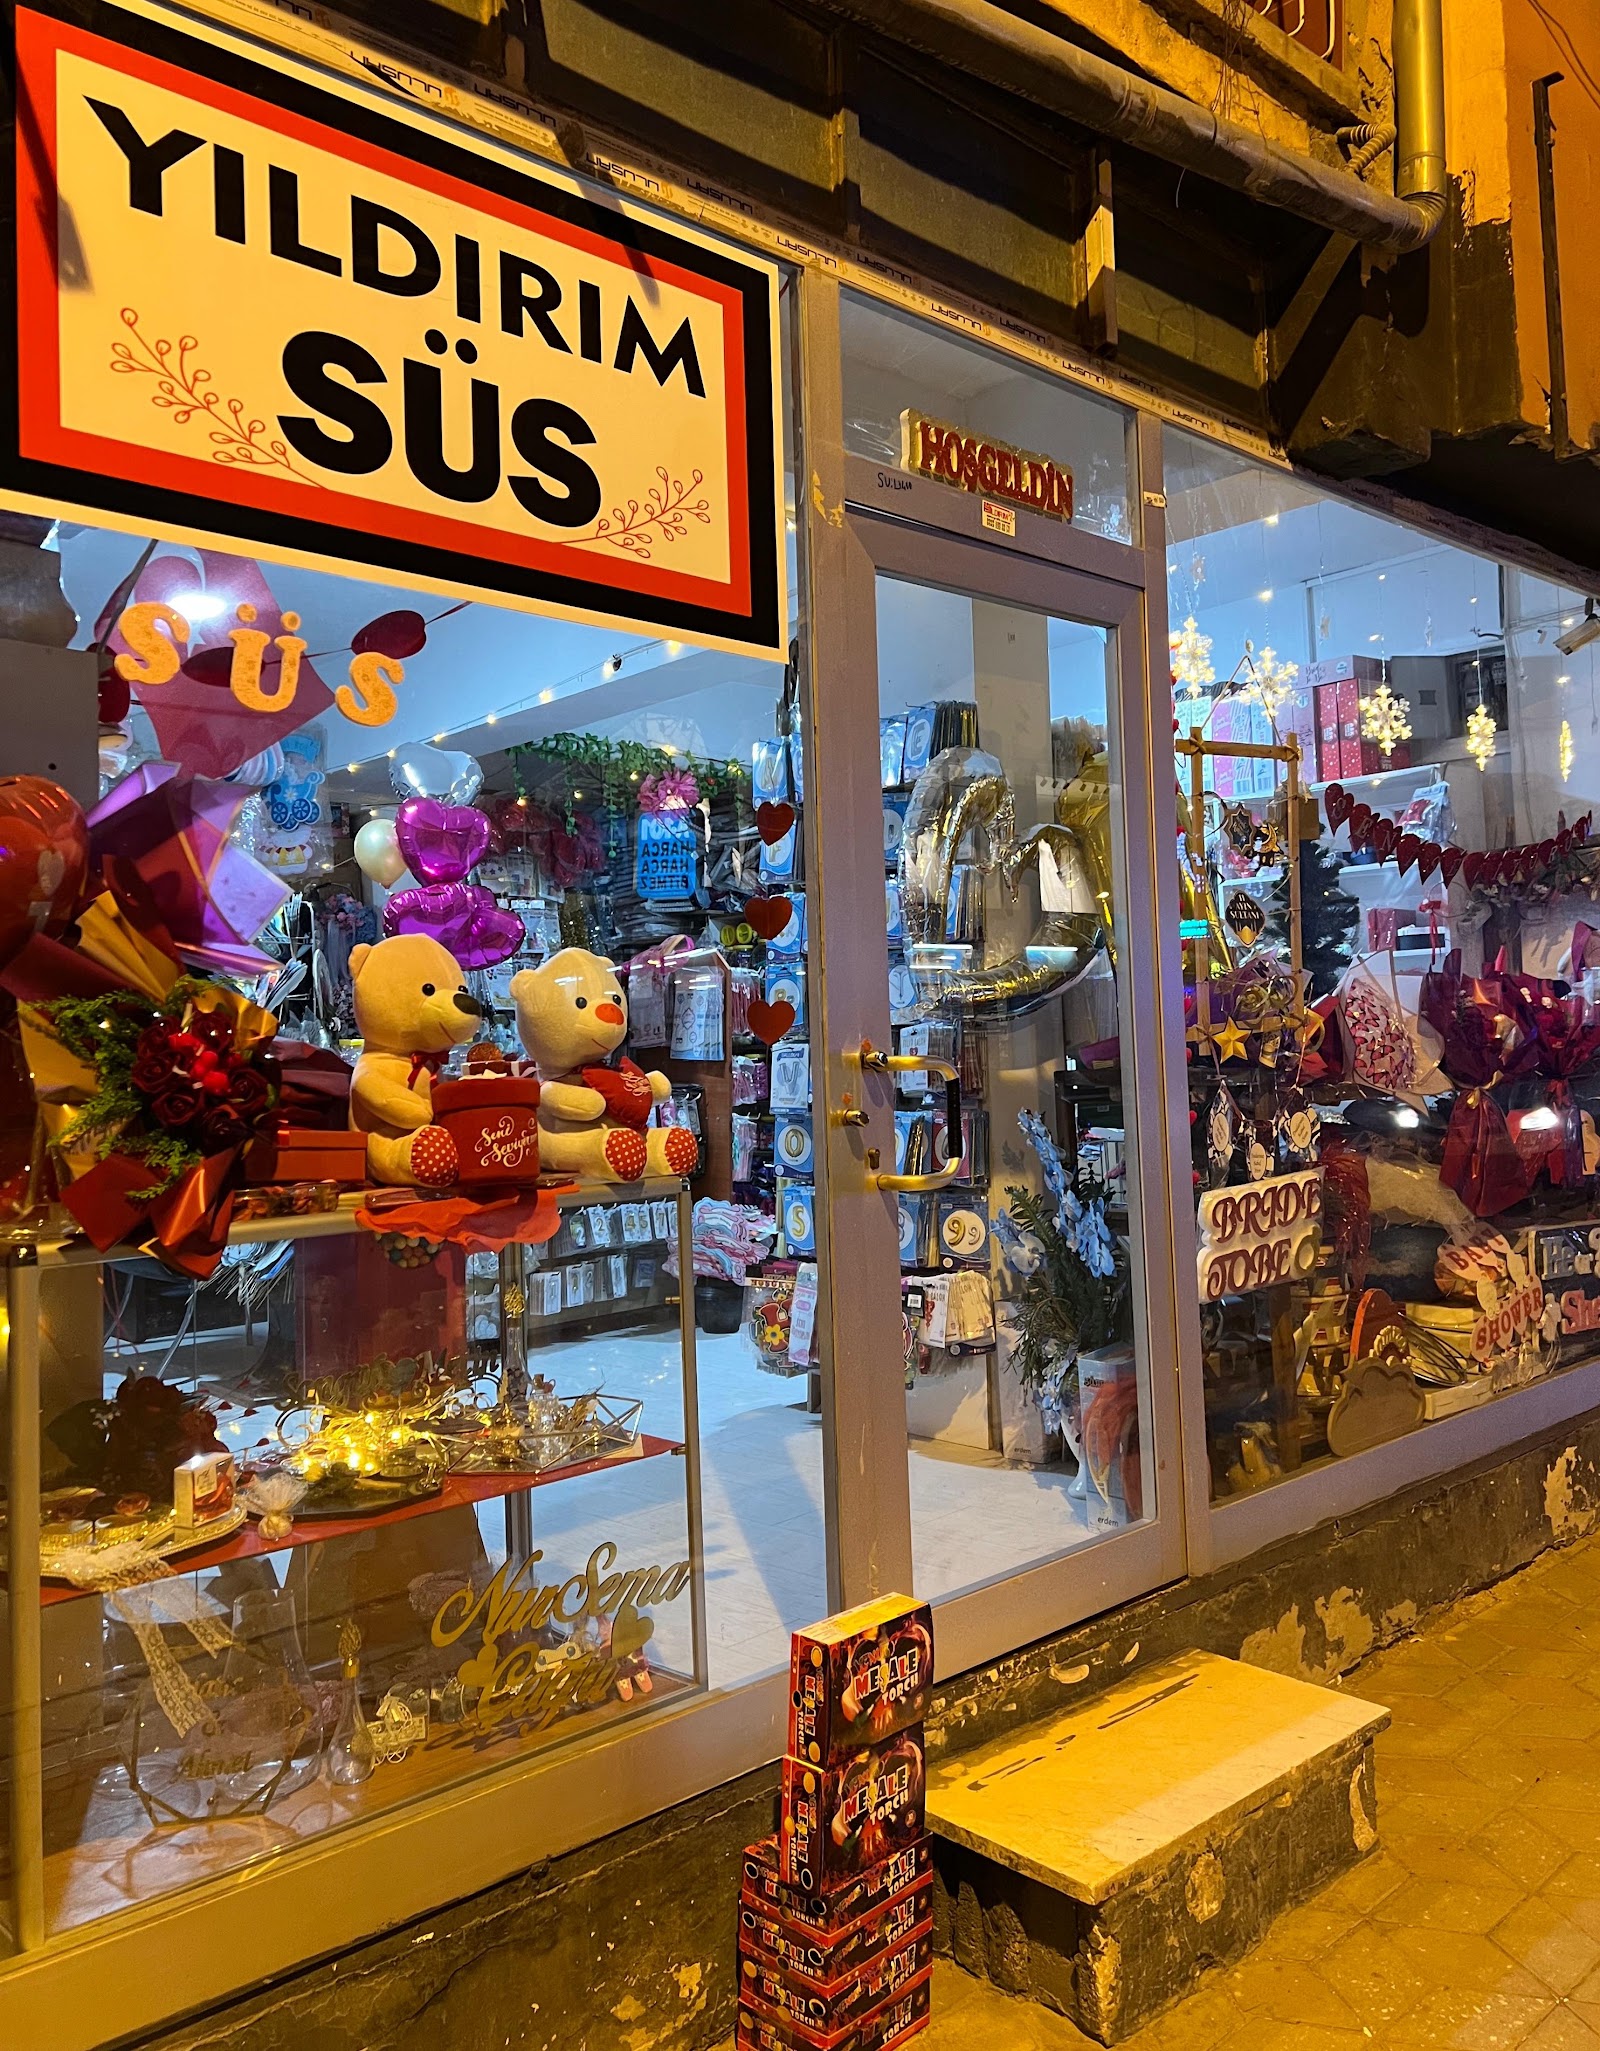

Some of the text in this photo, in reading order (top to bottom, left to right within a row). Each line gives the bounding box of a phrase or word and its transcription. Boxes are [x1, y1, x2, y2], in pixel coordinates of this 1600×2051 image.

[585, 151, 660, 193] ULUSAN
[82, 95, 706, 398] YILDIRIM
[777, 234, 837, 269] ULUSAN
[931, 302, 982, 331] ULUSAN
[277, 328, 601, 528] SÜS
[1211, 1177, 1321, 1244] BRIDE
[1445, 1228, 1504, 1271] BABY
[1475, 1286, 1542, 1351] SHOWER
[1097, 1515, 1120, 1528] erdem
[881, 1672, 919, 1706] TORCH
[797, 1710, 805, 1745] TORCH
[869, 1788, 909, 1826] TORCH
[790, 1836, 798, 1871] TORCH
[888, 1866, 916, 1897] TORCH
[886, 1914, 915, 1946] TORCH
[889, 1962, 916, 1994] TORCH
[882, 2009, 913, 2045] TORCH
